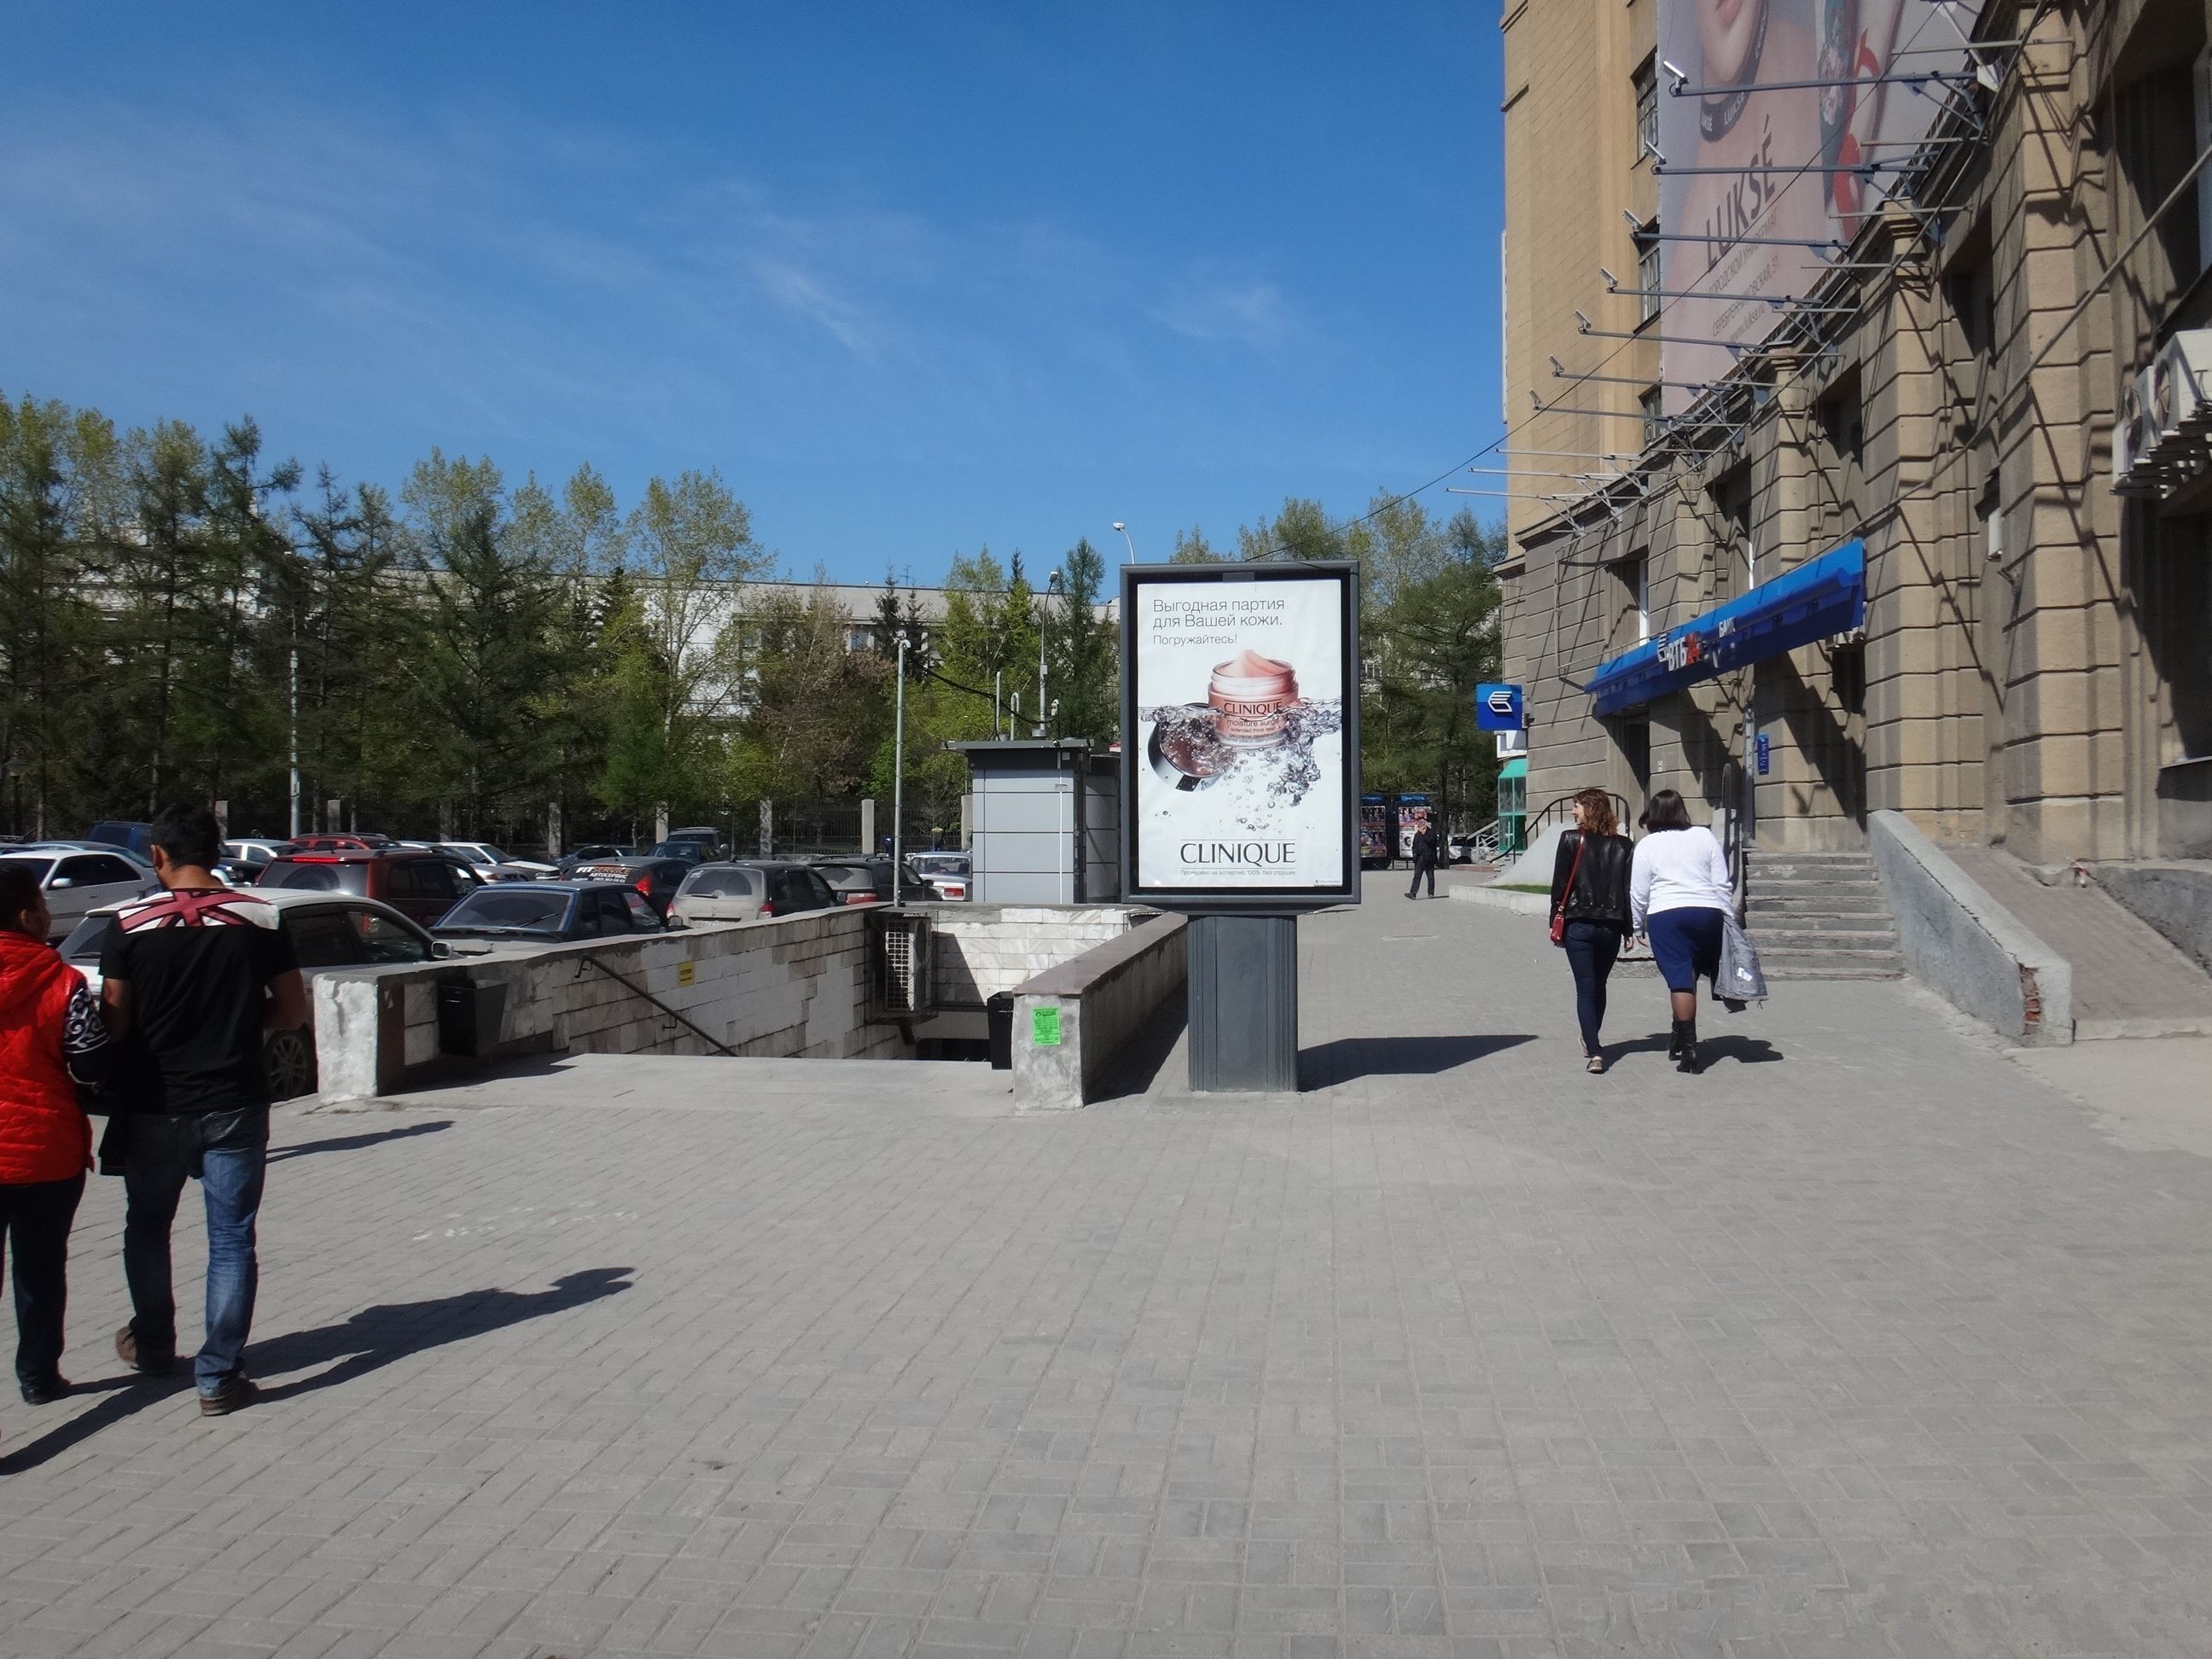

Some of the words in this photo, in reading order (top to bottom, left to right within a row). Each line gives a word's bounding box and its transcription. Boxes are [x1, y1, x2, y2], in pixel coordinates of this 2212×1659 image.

[1707, 113, 1775, 273] LUKSÉ
[1153, 599, 1227, 614] Выгодная
[1231, 599, 1284, 613] партия
[1152, 617, 1180, 631] для
[1185, 614, 1236, 627] Вашей
[1240, 615, 1283, 626] кожи.
[1153, 634, 1237, 647] Погружайтесь!
[1224, 701, 1283, 716] CLINIQUE
[1179, 842, 1296, 867] CLINIQUE
